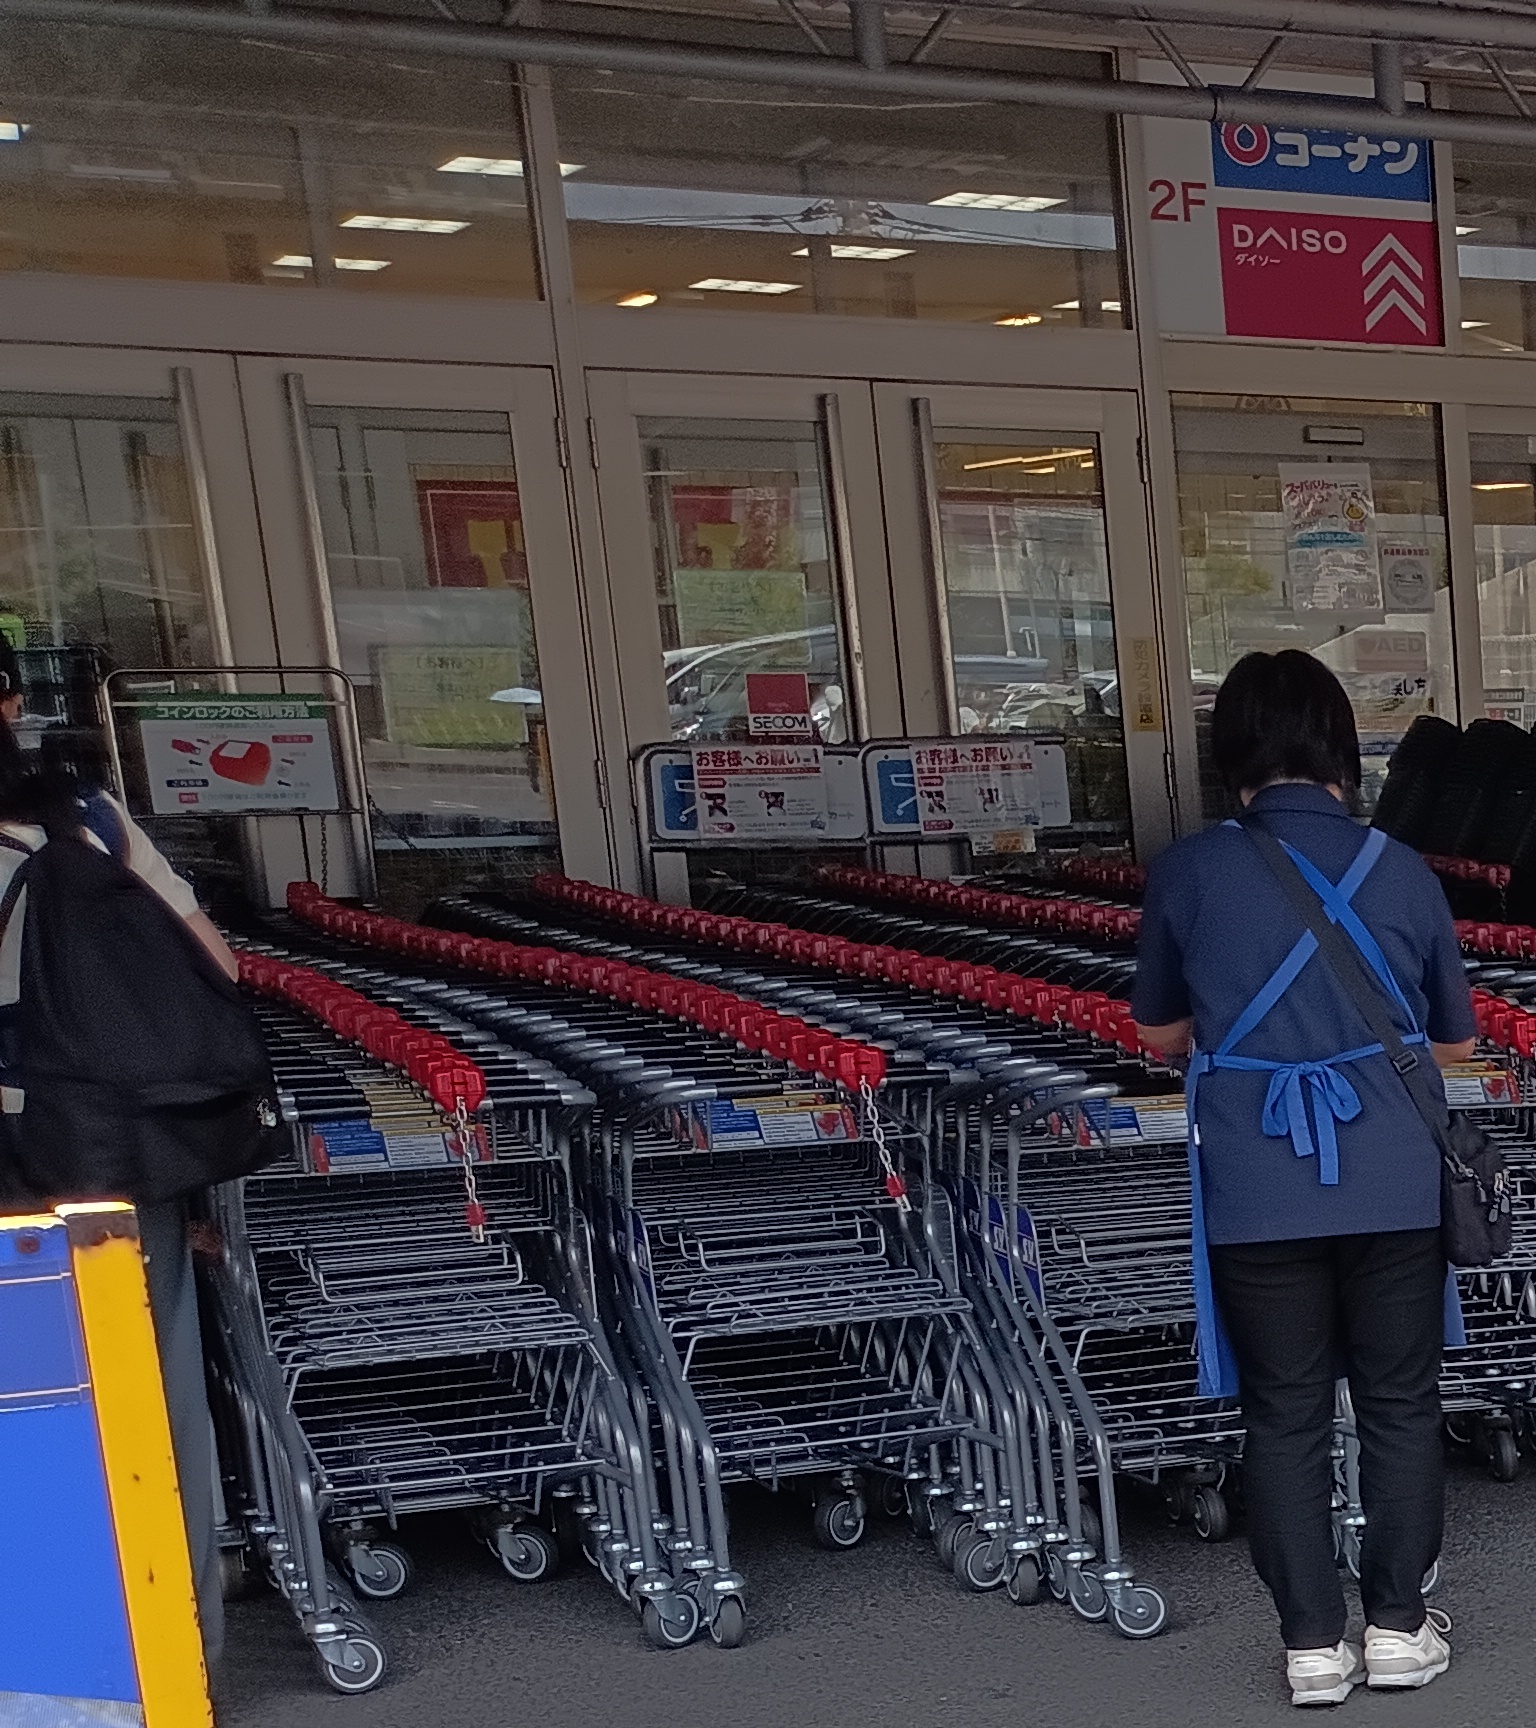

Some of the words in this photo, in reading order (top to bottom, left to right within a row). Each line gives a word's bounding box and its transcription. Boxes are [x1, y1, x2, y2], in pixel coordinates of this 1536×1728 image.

[1274, 132, 1419, 175] コーナン
[1148, 179, 1207, 222] 2F
[1232, 224, 1348, 254] DAISO
[1235, 254, 1282, 268] ダイソー
[1374, 634, 1425, 653] AED
[753, 716, 808, 729] SECOM
